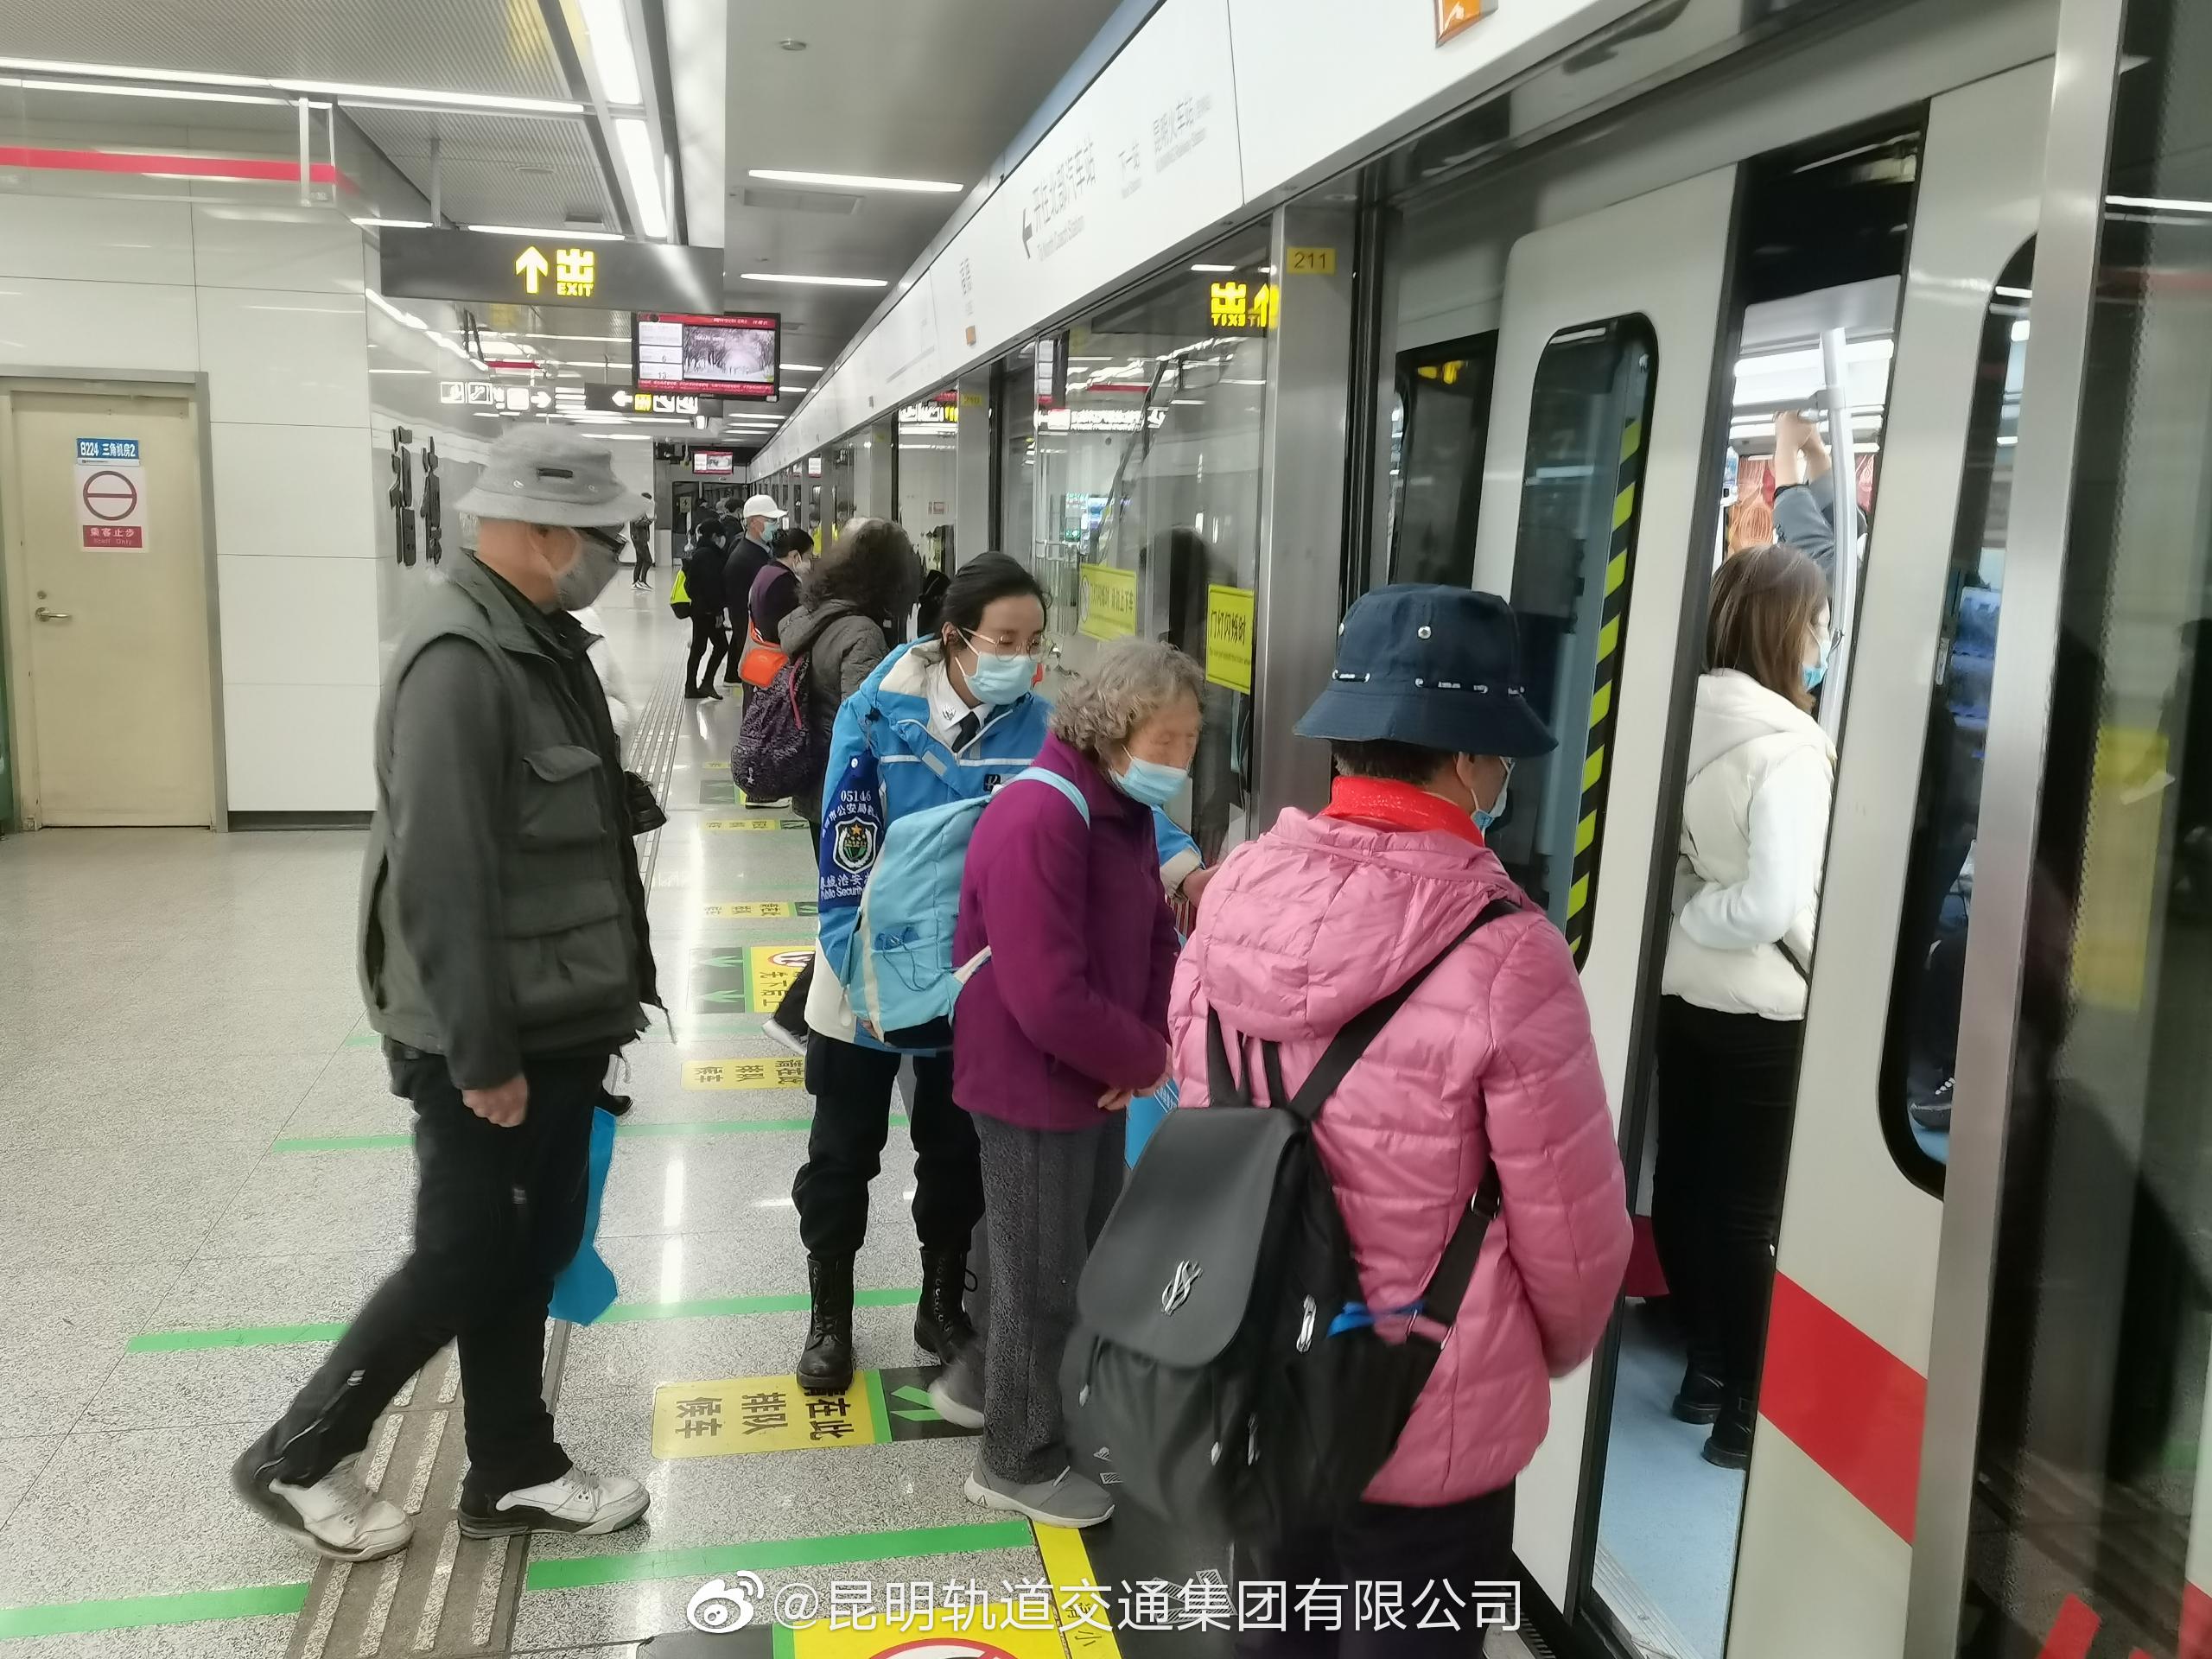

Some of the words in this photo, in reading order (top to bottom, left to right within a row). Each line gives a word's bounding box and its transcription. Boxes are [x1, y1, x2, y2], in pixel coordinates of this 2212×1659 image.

[1033, 133, 1096, 232] 开往北部汽车站
[556, 249, 594, 283] 出
[1294, 252, 1326, 270] 211
[556, 283, 594, 297] EXIT
[1210, 609, 1247, 646] 门灯闪烁时
[675, 1396, 723, 1440] 候车
[741, 1392, 789, 1436] 排队
